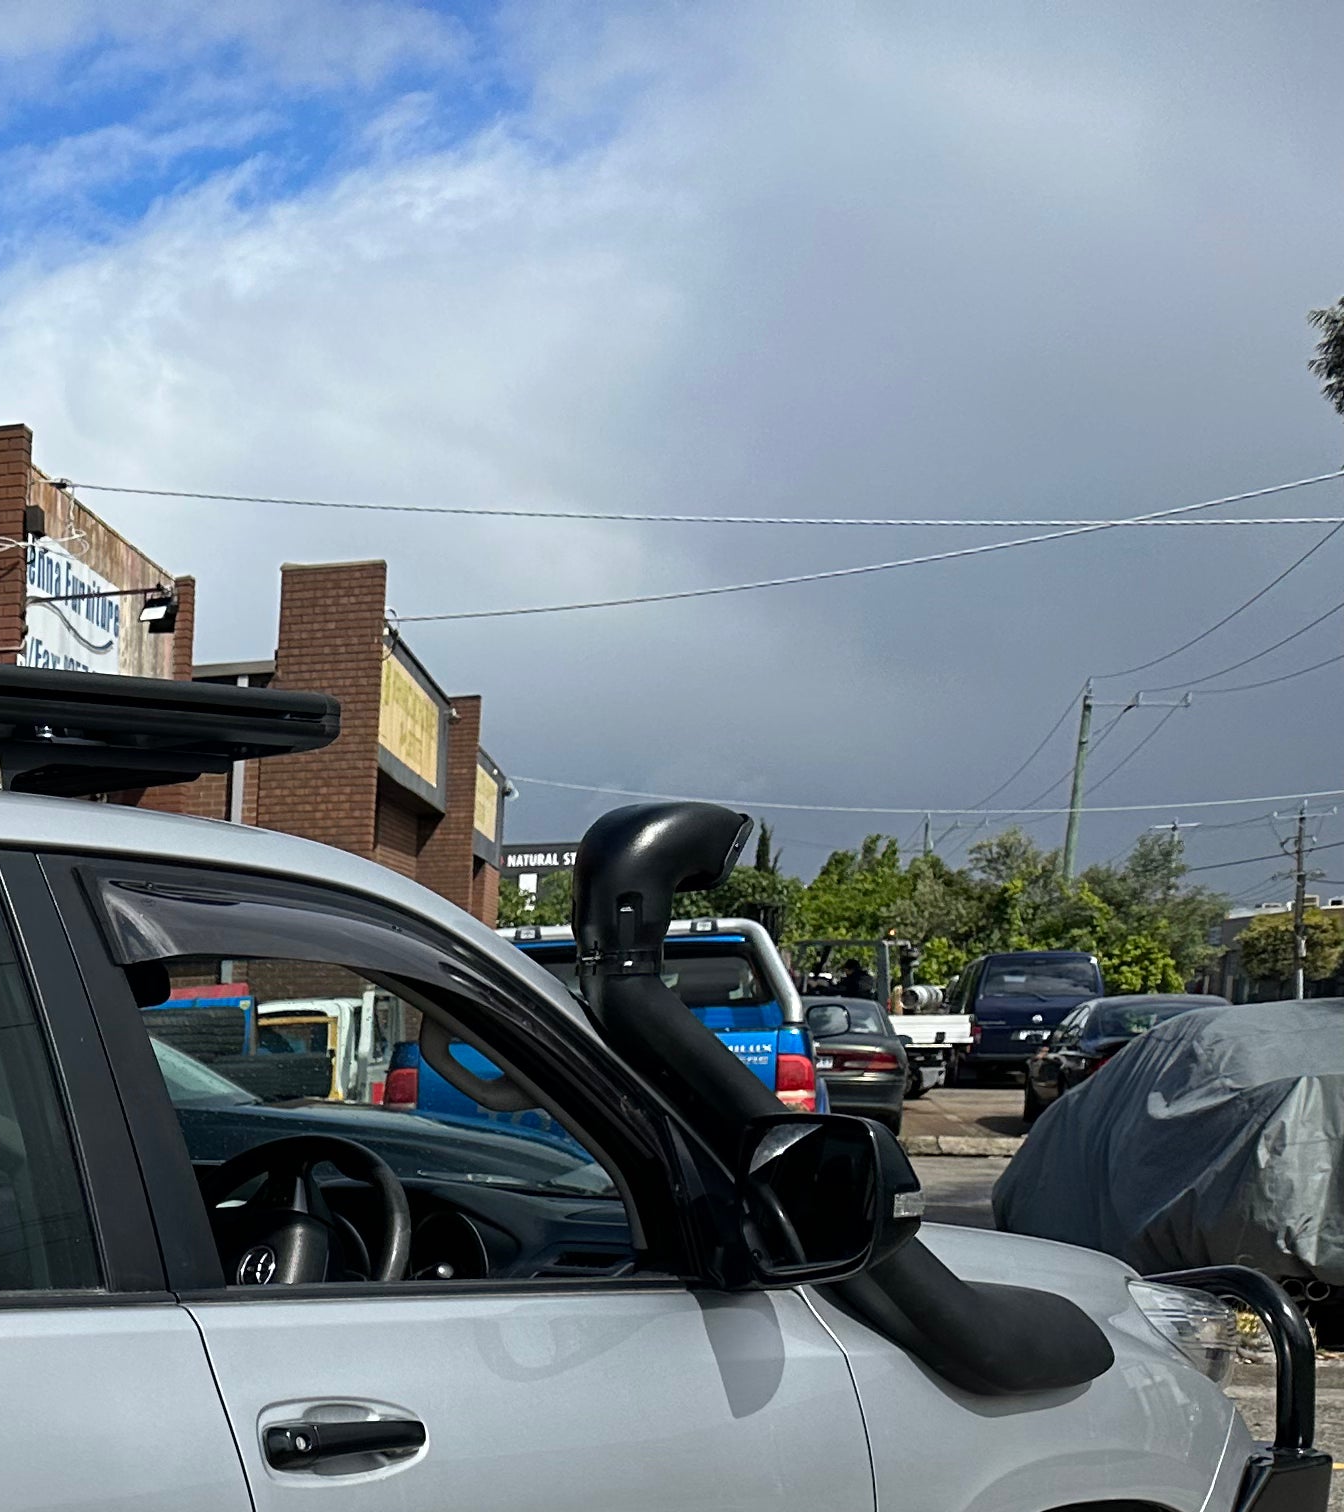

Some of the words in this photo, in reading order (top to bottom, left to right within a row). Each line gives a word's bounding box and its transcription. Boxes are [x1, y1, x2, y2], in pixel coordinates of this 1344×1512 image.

[27, 549, 62, 598] enna
[65, 561, 120, 638] Furniture
[507, 852, 559, 867] NATURAL
[563, 851, 577, 866] ST
